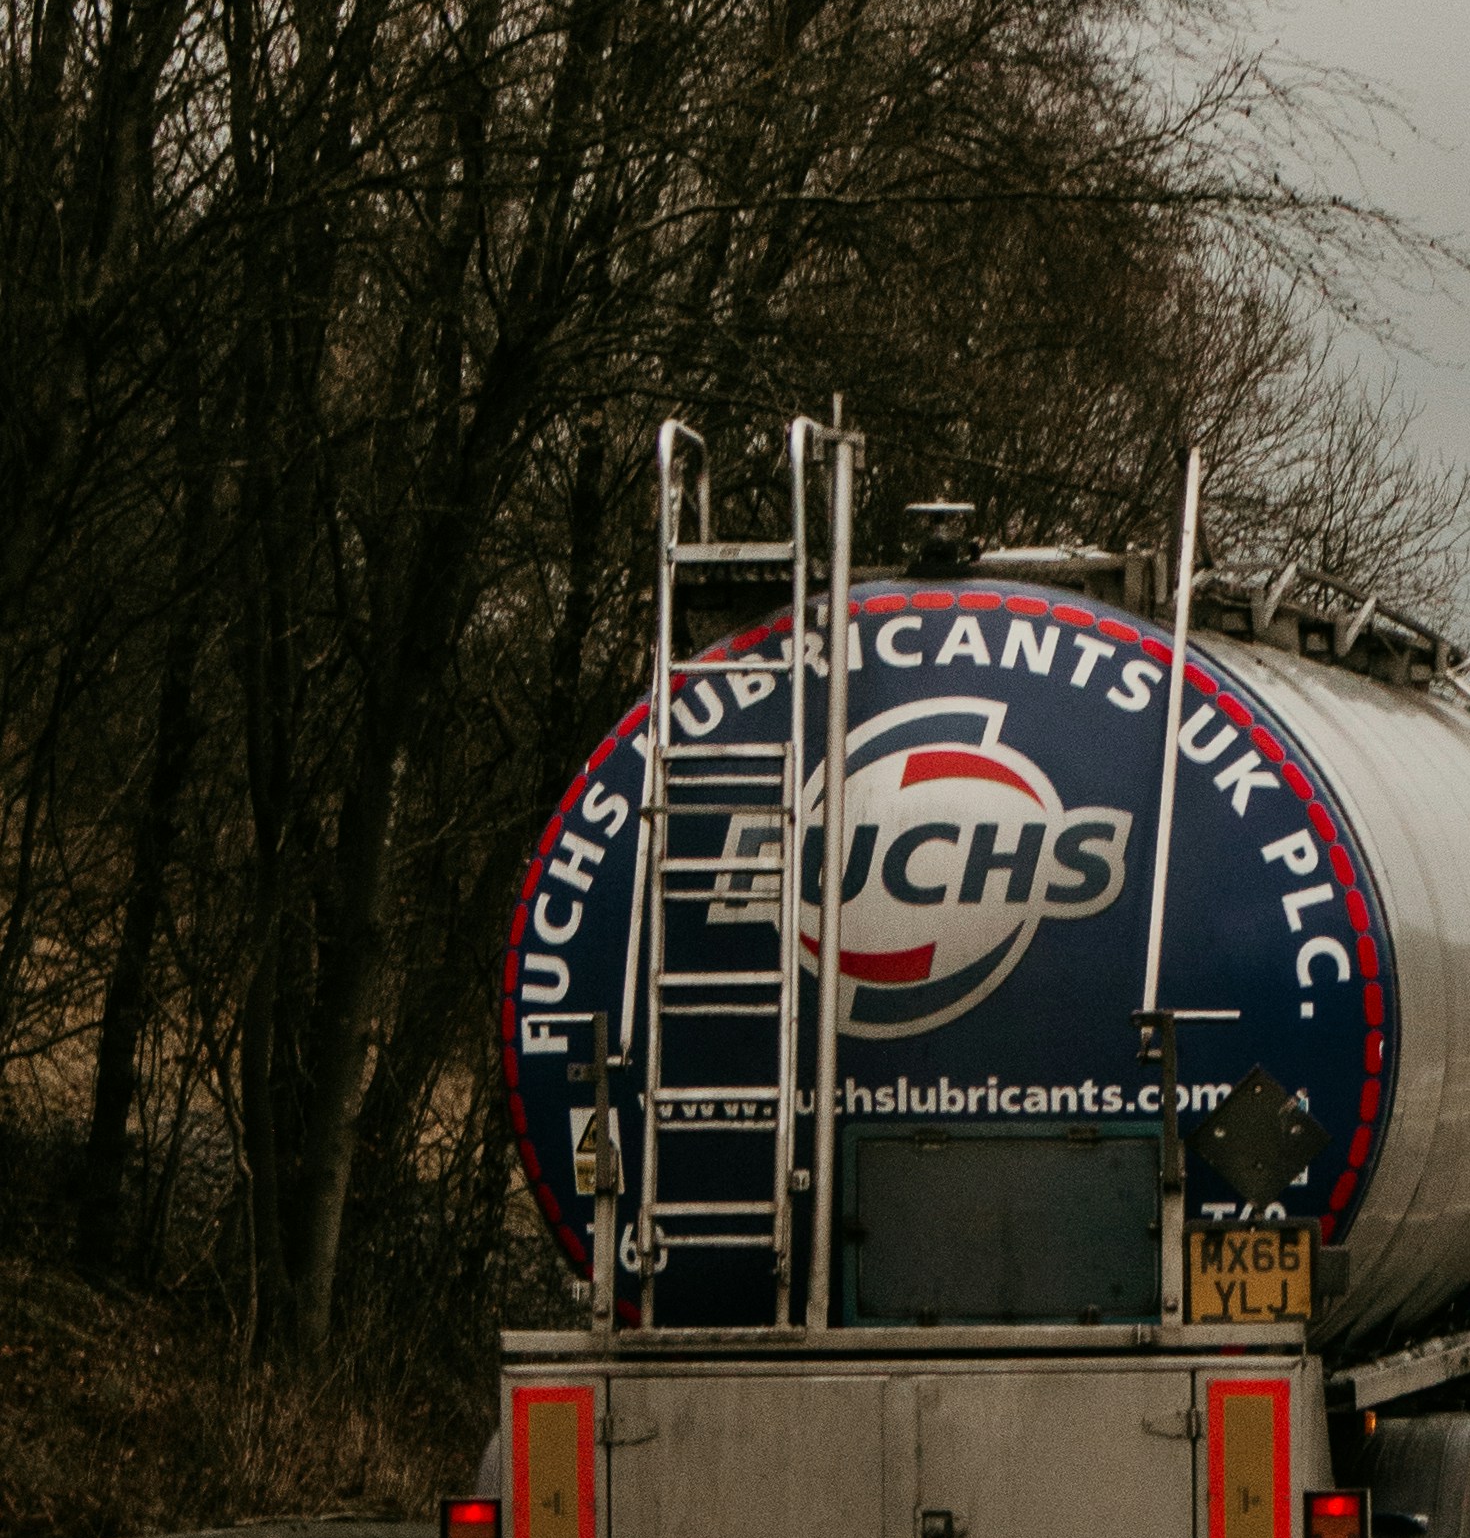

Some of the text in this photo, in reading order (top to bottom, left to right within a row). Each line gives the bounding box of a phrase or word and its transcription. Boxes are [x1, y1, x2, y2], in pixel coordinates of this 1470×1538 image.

[521, 780, 630, 1054] FUCHS
[1176, 703, 1281, 819] UK
[1260, 827, 1352, 1020] PLC.
[1213, 1277, 1288, 1315] YLJ
